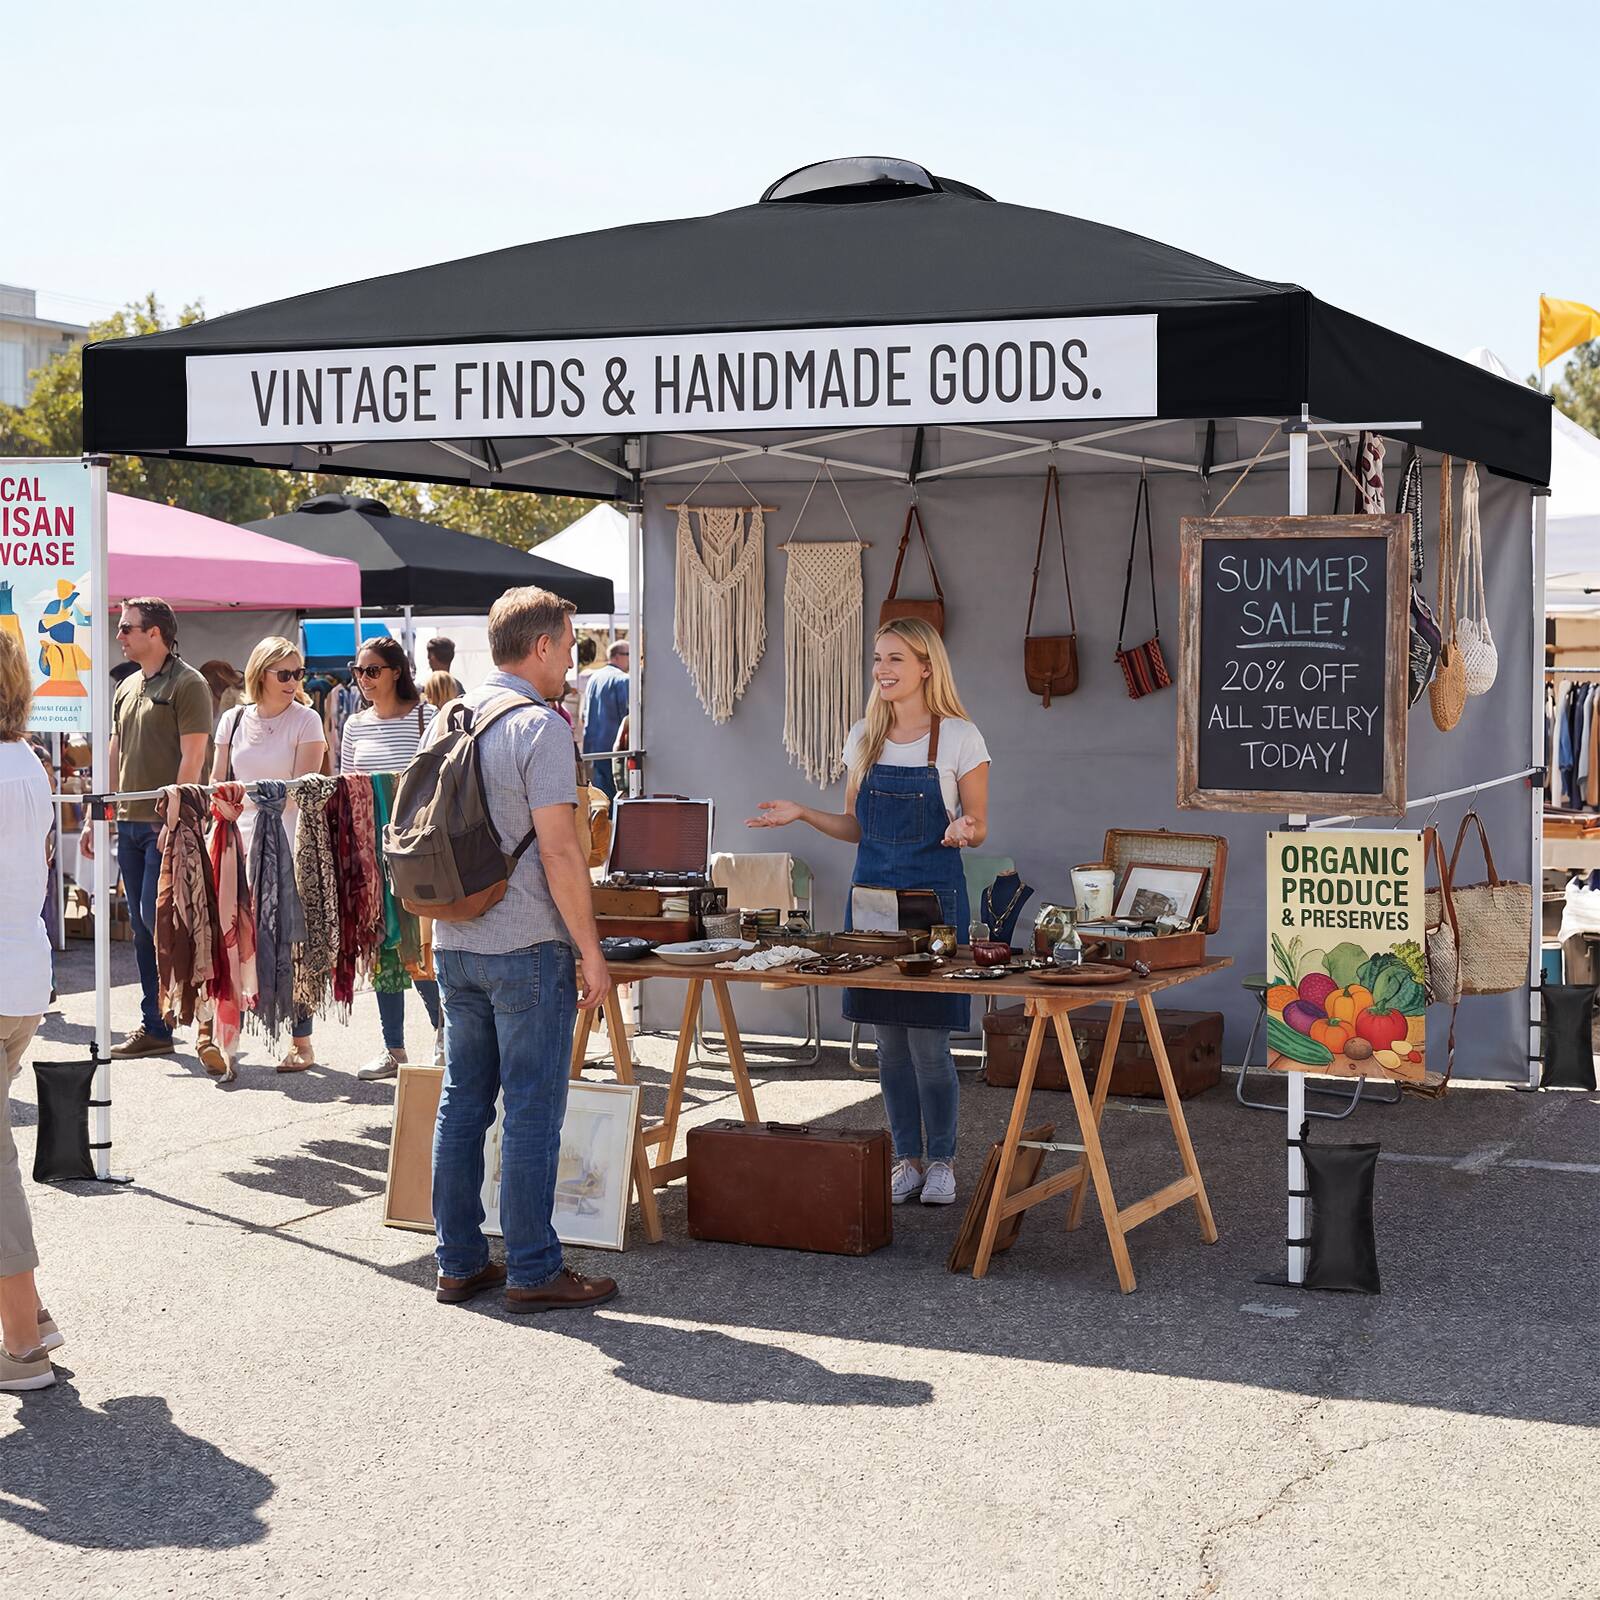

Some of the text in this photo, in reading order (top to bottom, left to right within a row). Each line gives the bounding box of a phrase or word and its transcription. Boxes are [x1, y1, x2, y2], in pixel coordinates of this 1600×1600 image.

[250, 338, 1102, 427] VINTAGE FINDS & HANDMADE GOODS.
[0, 477, 47, 502] CAL
[2, 506, 74, 537] ISAN
[1216, 555, 1370, 593] SUMMER
[1240, 596, 1350, 637] SALE!
[1220, 659, 1360, 693] 20% OFF
[1207, 703, 1379, 737] ALL JEWELRY
[1239, 738, 1348, 775] TODAY!
[1281, 845, 1410, 876] ORGANIC
[1281, 877, 1409, 907] PRODUCE
[1281, 907, 1409, 931] & PRESERVES
